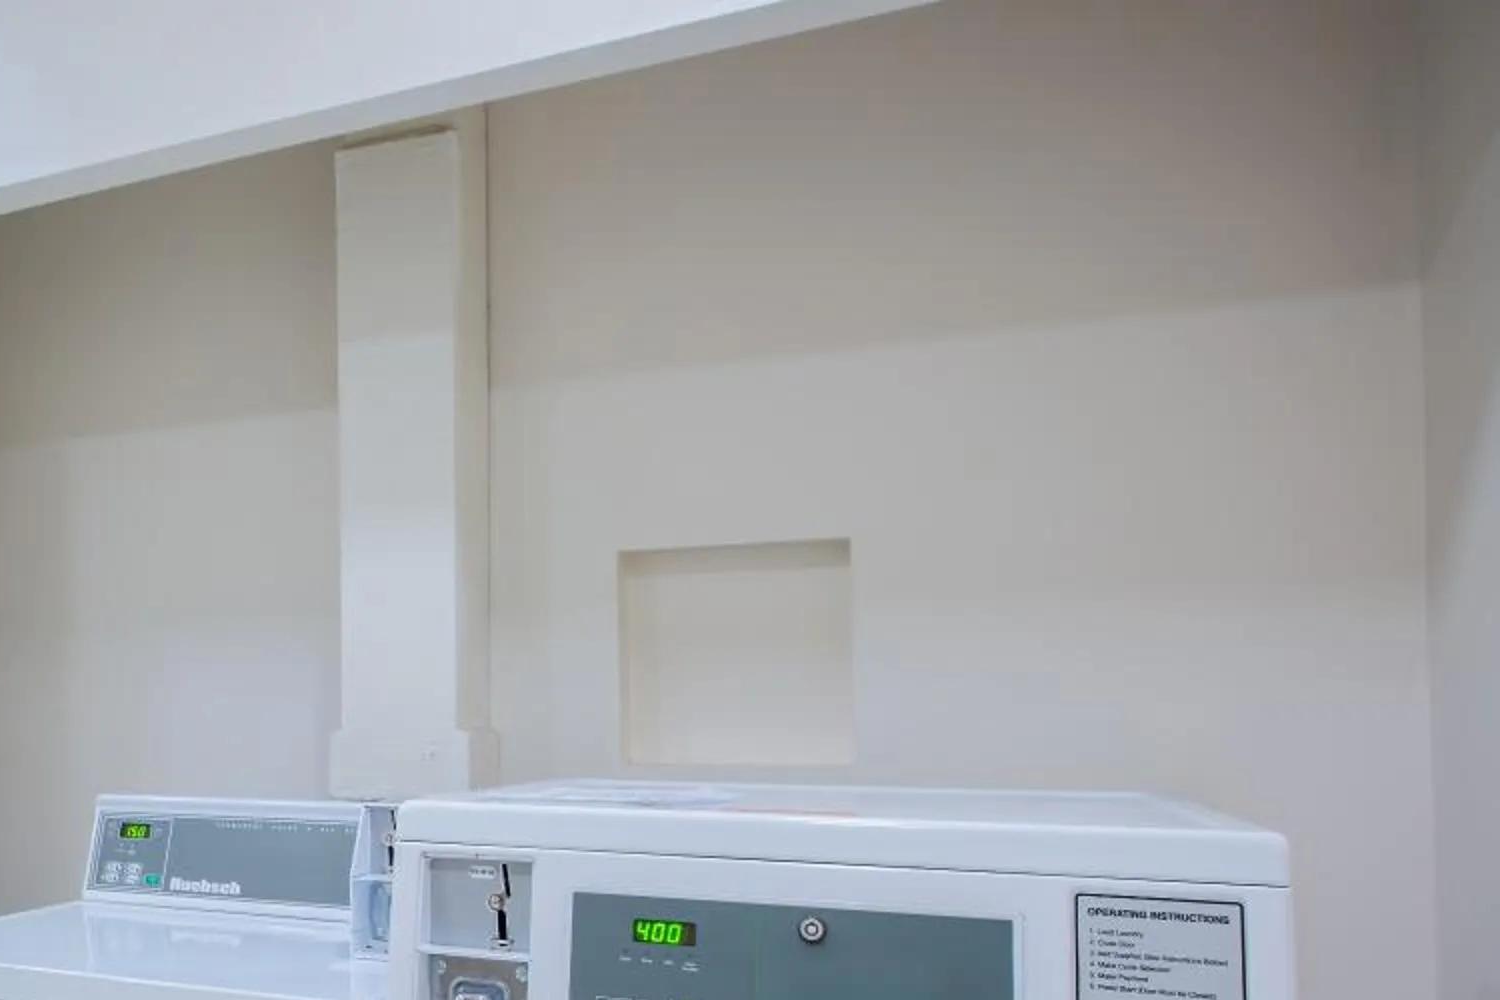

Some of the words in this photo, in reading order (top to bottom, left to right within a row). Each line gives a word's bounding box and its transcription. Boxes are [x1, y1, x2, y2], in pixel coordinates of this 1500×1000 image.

[169, 876, 241, 896] Huebsch
[1087, 907, 1147, 919] OPERATING
[1149, 911, 1230, 925] INSTRUCTIONS
[636, 920, 682, 944] 400
